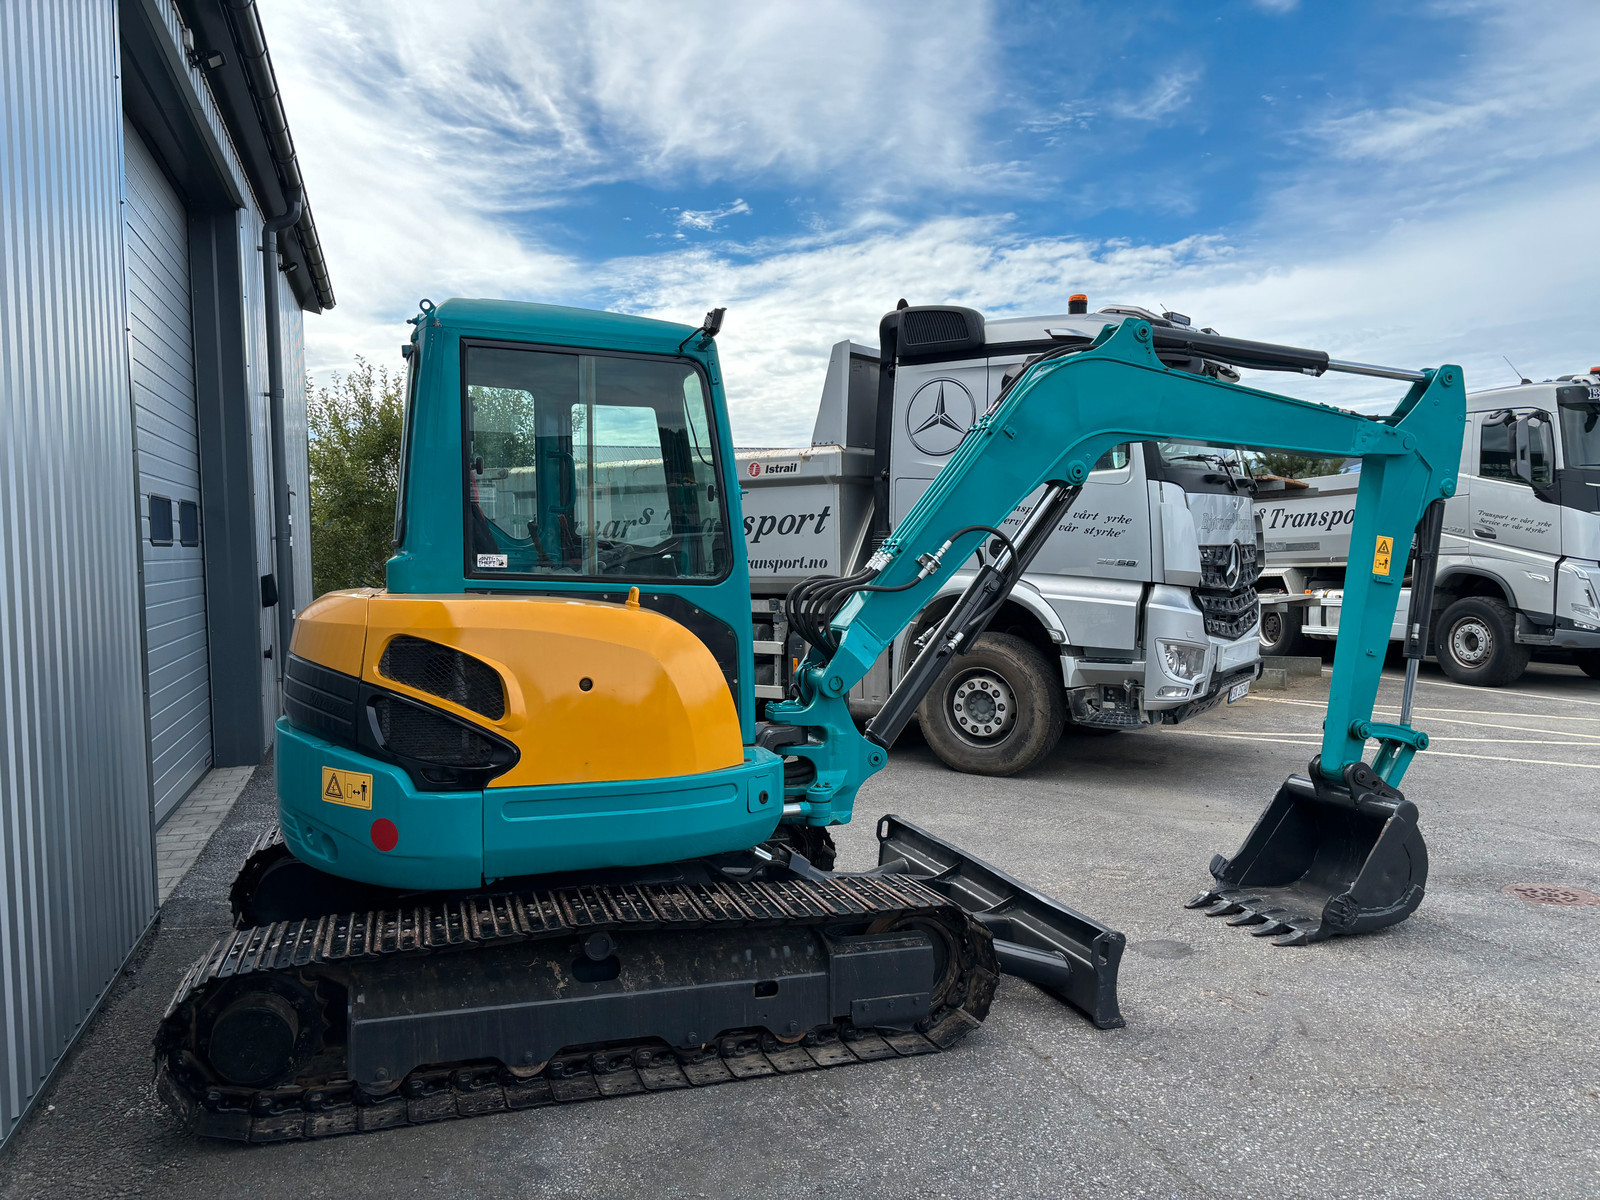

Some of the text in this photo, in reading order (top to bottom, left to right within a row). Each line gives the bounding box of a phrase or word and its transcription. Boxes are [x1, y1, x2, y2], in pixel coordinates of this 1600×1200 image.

[765, 463, 797, 474] Istrail
[1073, 510, 1099, 521] vårt
[1104, 514, 1132, 525] yrke
[1269, 508, 1355, 531] Transpo
[1058, 522, 1079, 533] vår
[748, 556, 828, 573] ansport.no
